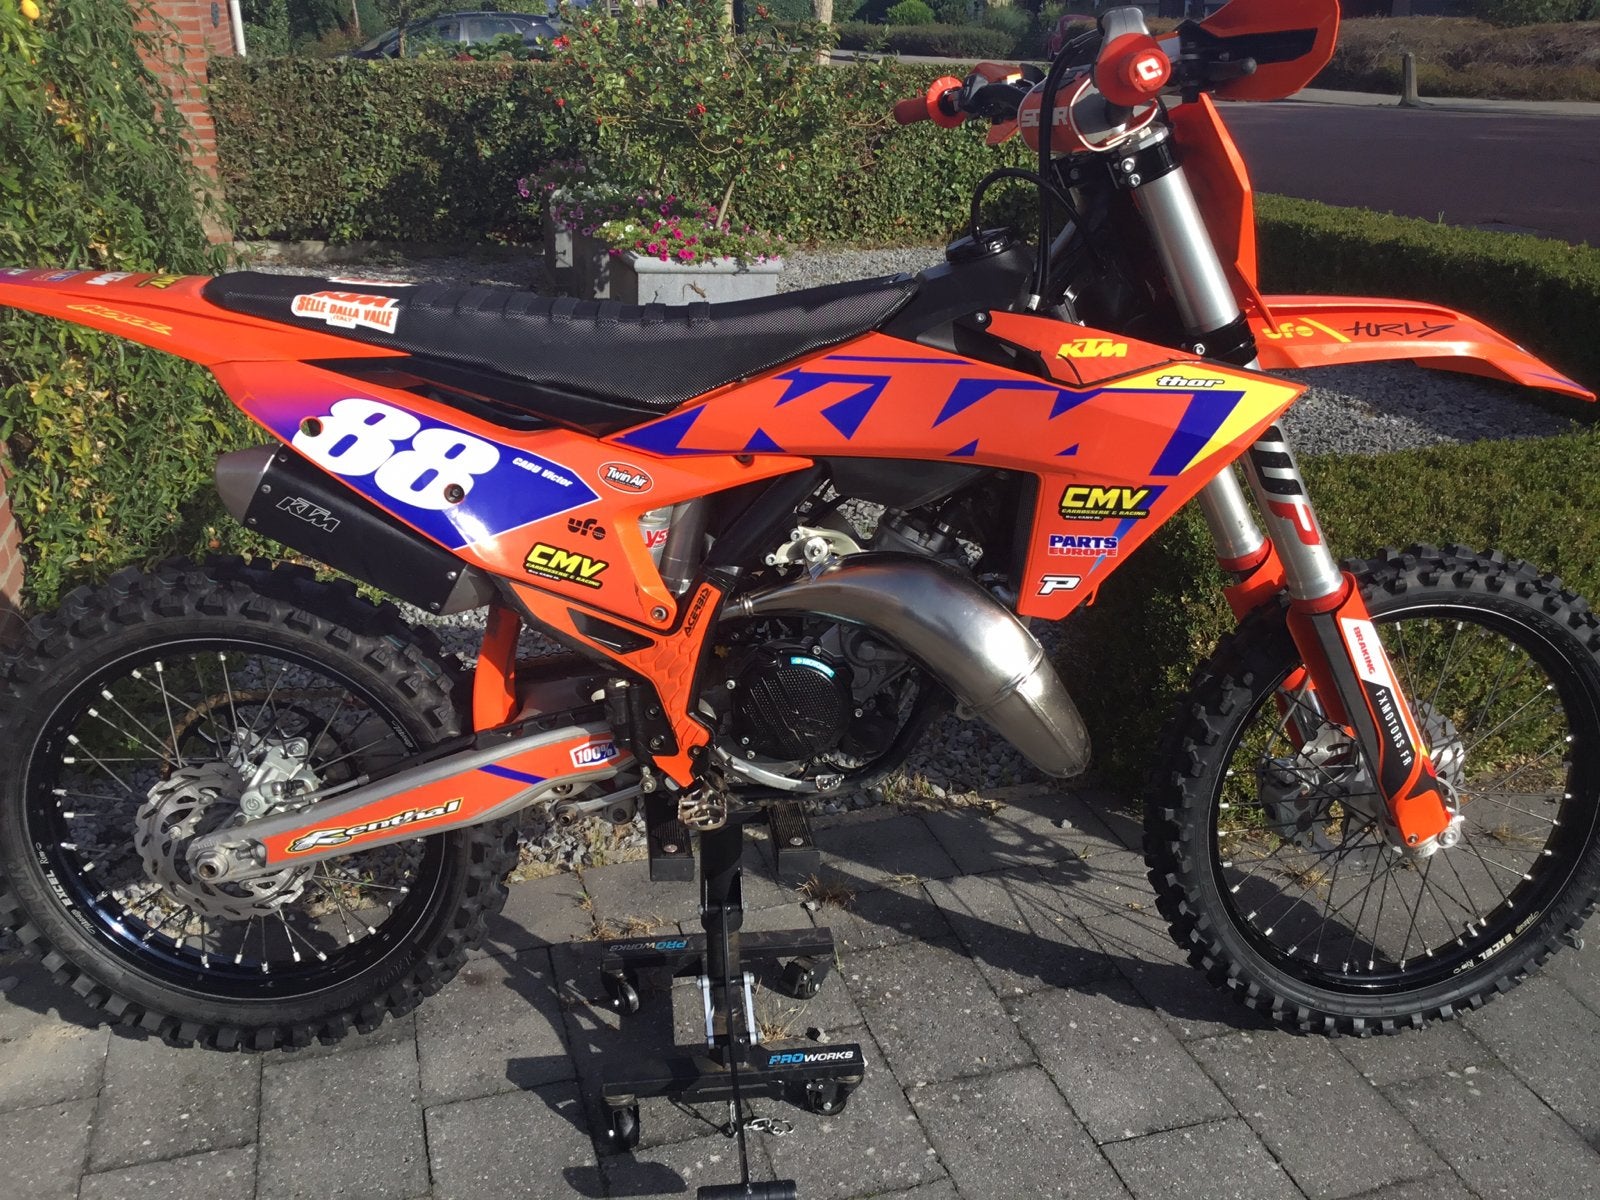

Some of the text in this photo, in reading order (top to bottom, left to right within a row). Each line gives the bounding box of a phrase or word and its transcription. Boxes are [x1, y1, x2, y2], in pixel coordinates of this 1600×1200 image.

[297, 296, 393, 327] SELLE DALLA VALLE
[1056, 338, 1128, 359] KTM
[1157, 375, 1224, 389] thor
[675, 361, 1194, 475] KTM
[291, 398, 500, 510] 88
[541, 470, 573, 488] Victor
[607, 466, 631, 482] Twin
[630, 475, 648, 487] Air
[1061, 487, 1149, 510] CMV
[276, 496, 341, 532] KTM
[645, 528, 668, 548] YS
[1049, 534, 1118, 549] PARTS
[527, 544, 607, 578] CMV
[1048, 547, 1118, 557] EUROPE
[684, 588, 712, 637] ACERBIS
[1353, 626, 1377, 675] BRAKING
[576, 742, 613, 764] 100%
[290, 799, 461, 851] Renthal
[46, 869, 74, 907] EXCEL
[1478, 933, 1514, 960] EXCEL
[769, 1050, 854, 1066] PROWORKS
